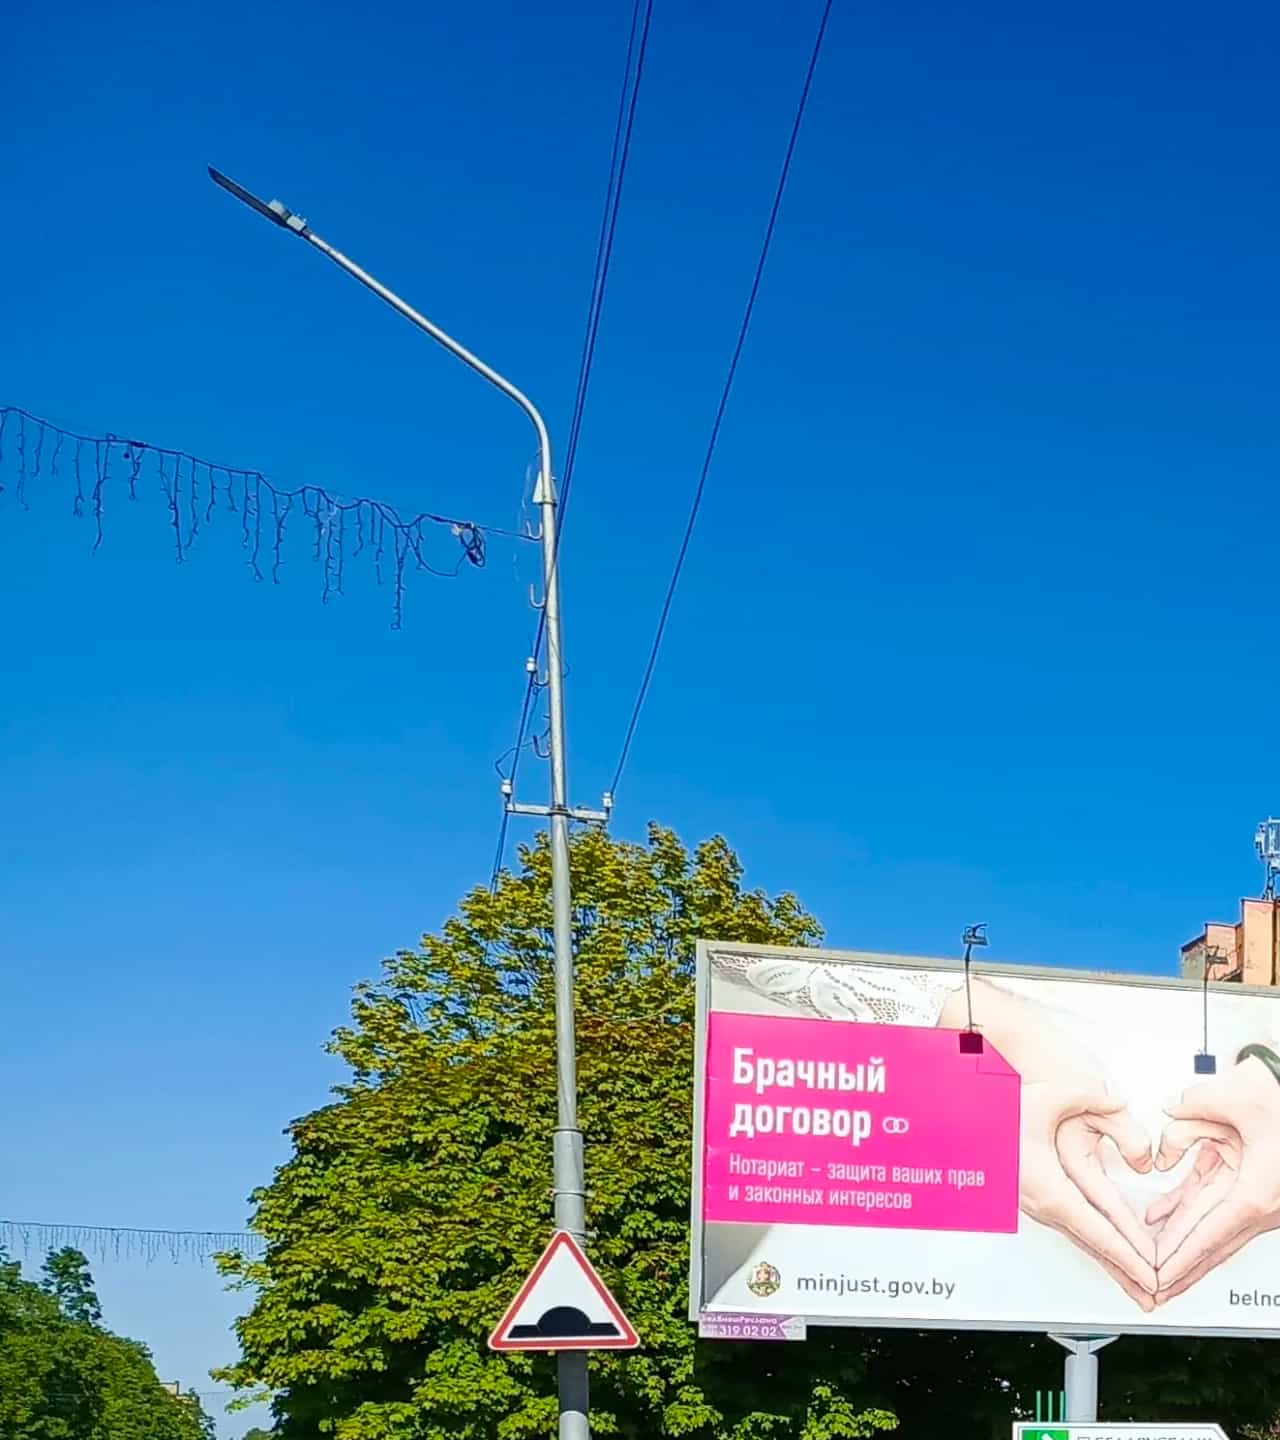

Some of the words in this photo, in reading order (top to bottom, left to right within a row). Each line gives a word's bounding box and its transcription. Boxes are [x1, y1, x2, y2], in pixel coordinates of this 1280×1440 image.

[732, 1047, 886, 1094] Брачный
[729, 1104, 871, 1146] договор
[729, 1153, 804, 1180] Нотариат
[827, 1161, 887, 1185] защита
[892, 1165, 943, 1185] ваших
[948, 1168, 985, 1190] прав
[729, 1185, 739, 1201] и
[745, 1185, 823, 1206] законных
[829, 1191, 913, 1212] интересов
[797, 1273, 956, 1299] minjust.gov.by
